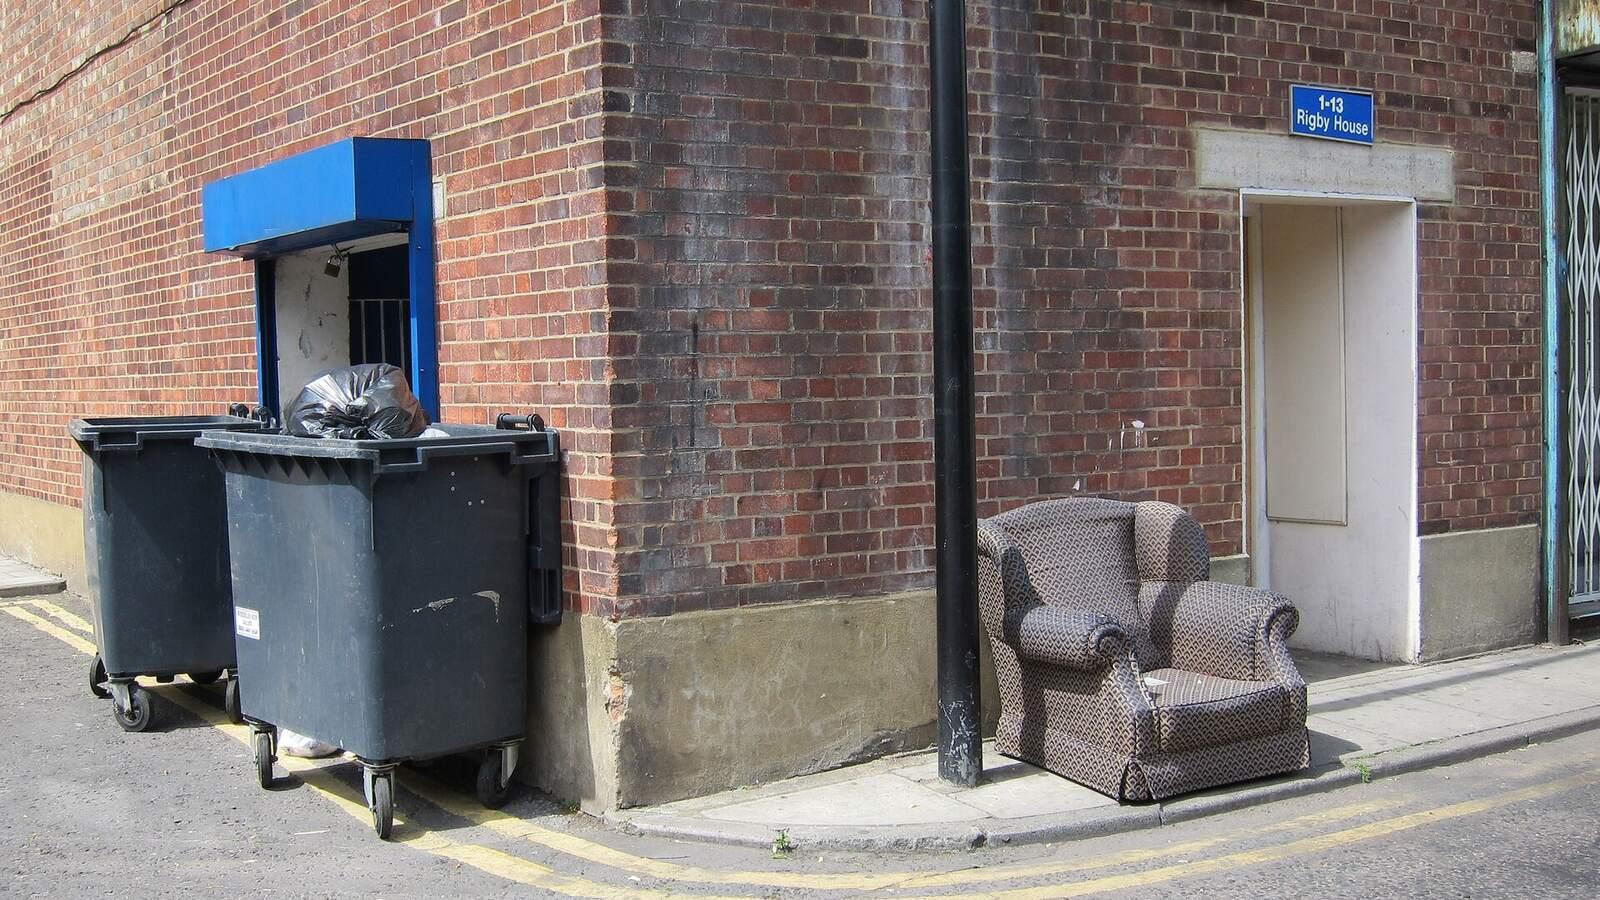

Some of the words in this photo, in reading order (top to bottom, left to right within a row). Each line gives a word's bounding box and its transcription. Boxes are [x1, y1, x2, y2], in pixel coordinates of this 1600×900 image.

[1318, 95, 1344, 114] 1-13
[1297, 108, 1330, 132] Rigby
[1334, 114, 1369, 136] House
